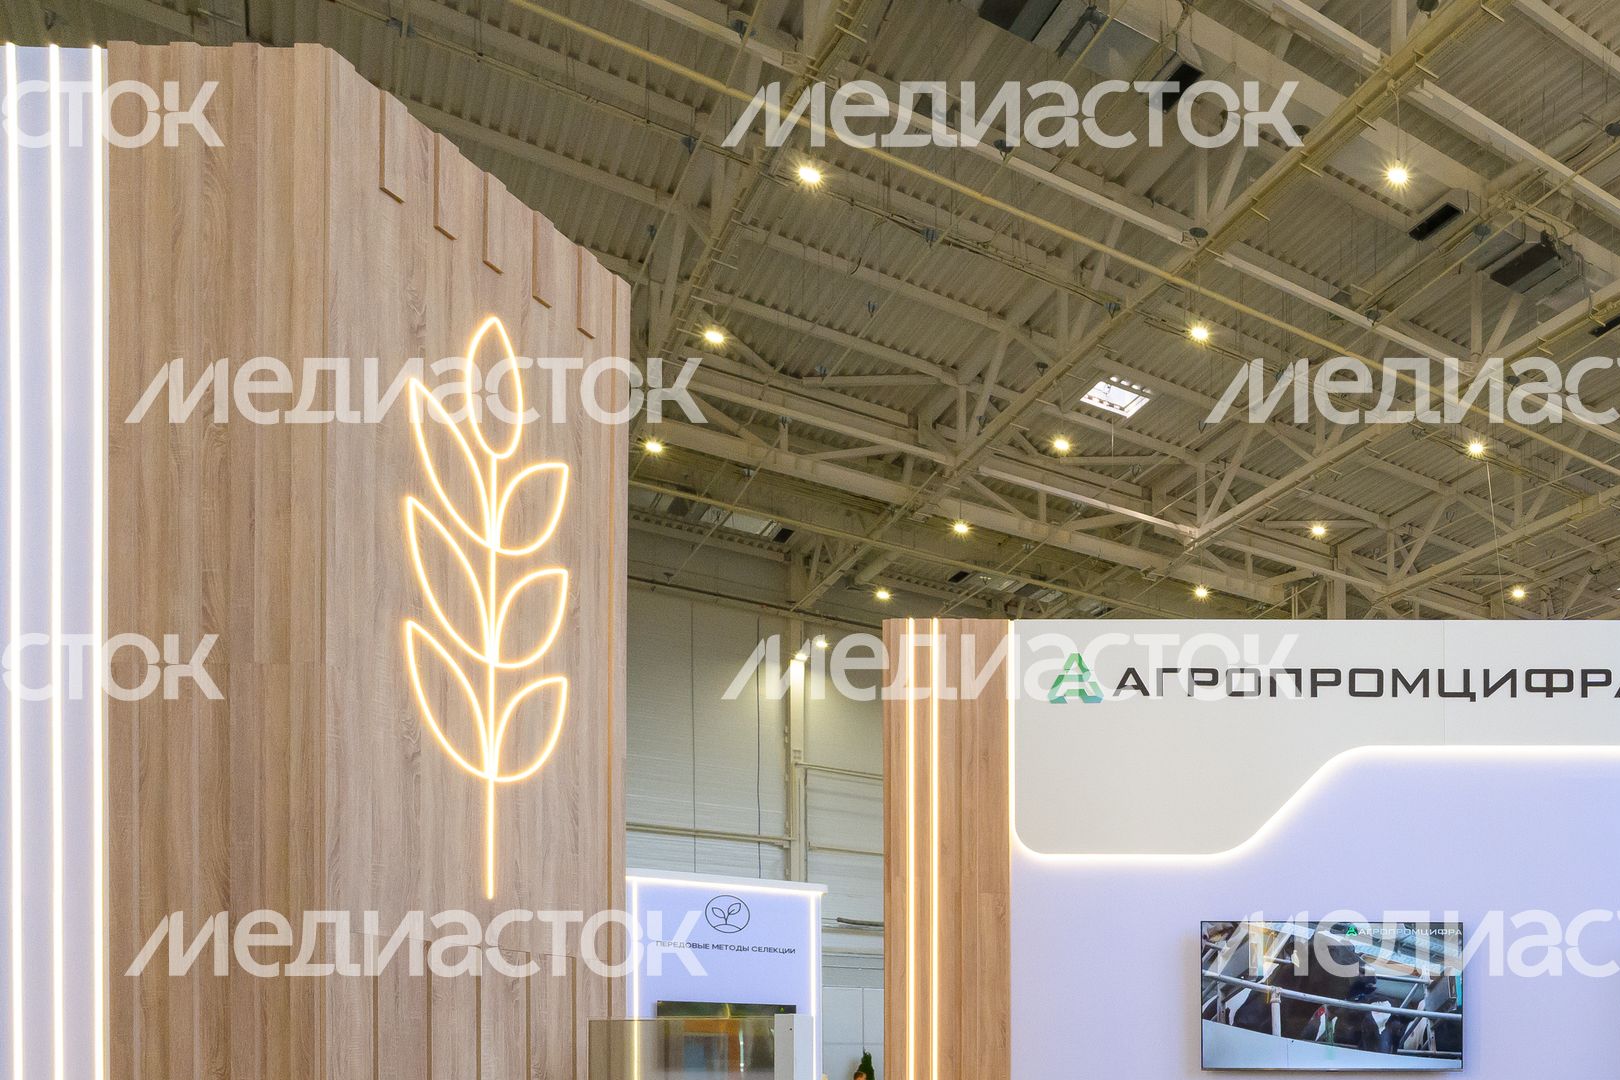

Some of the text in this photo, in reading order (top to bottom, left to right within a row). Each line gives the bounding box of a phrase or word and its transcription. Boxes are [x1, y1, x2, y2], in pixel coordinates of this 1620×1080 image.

[1358, 927, 1463, 937] АГРОПРОМЦИФРА
[656, 940, 796, 955] ПЕРЕДОВЫЕ МЕТОДЫ СЕЛЕКЦИИ
